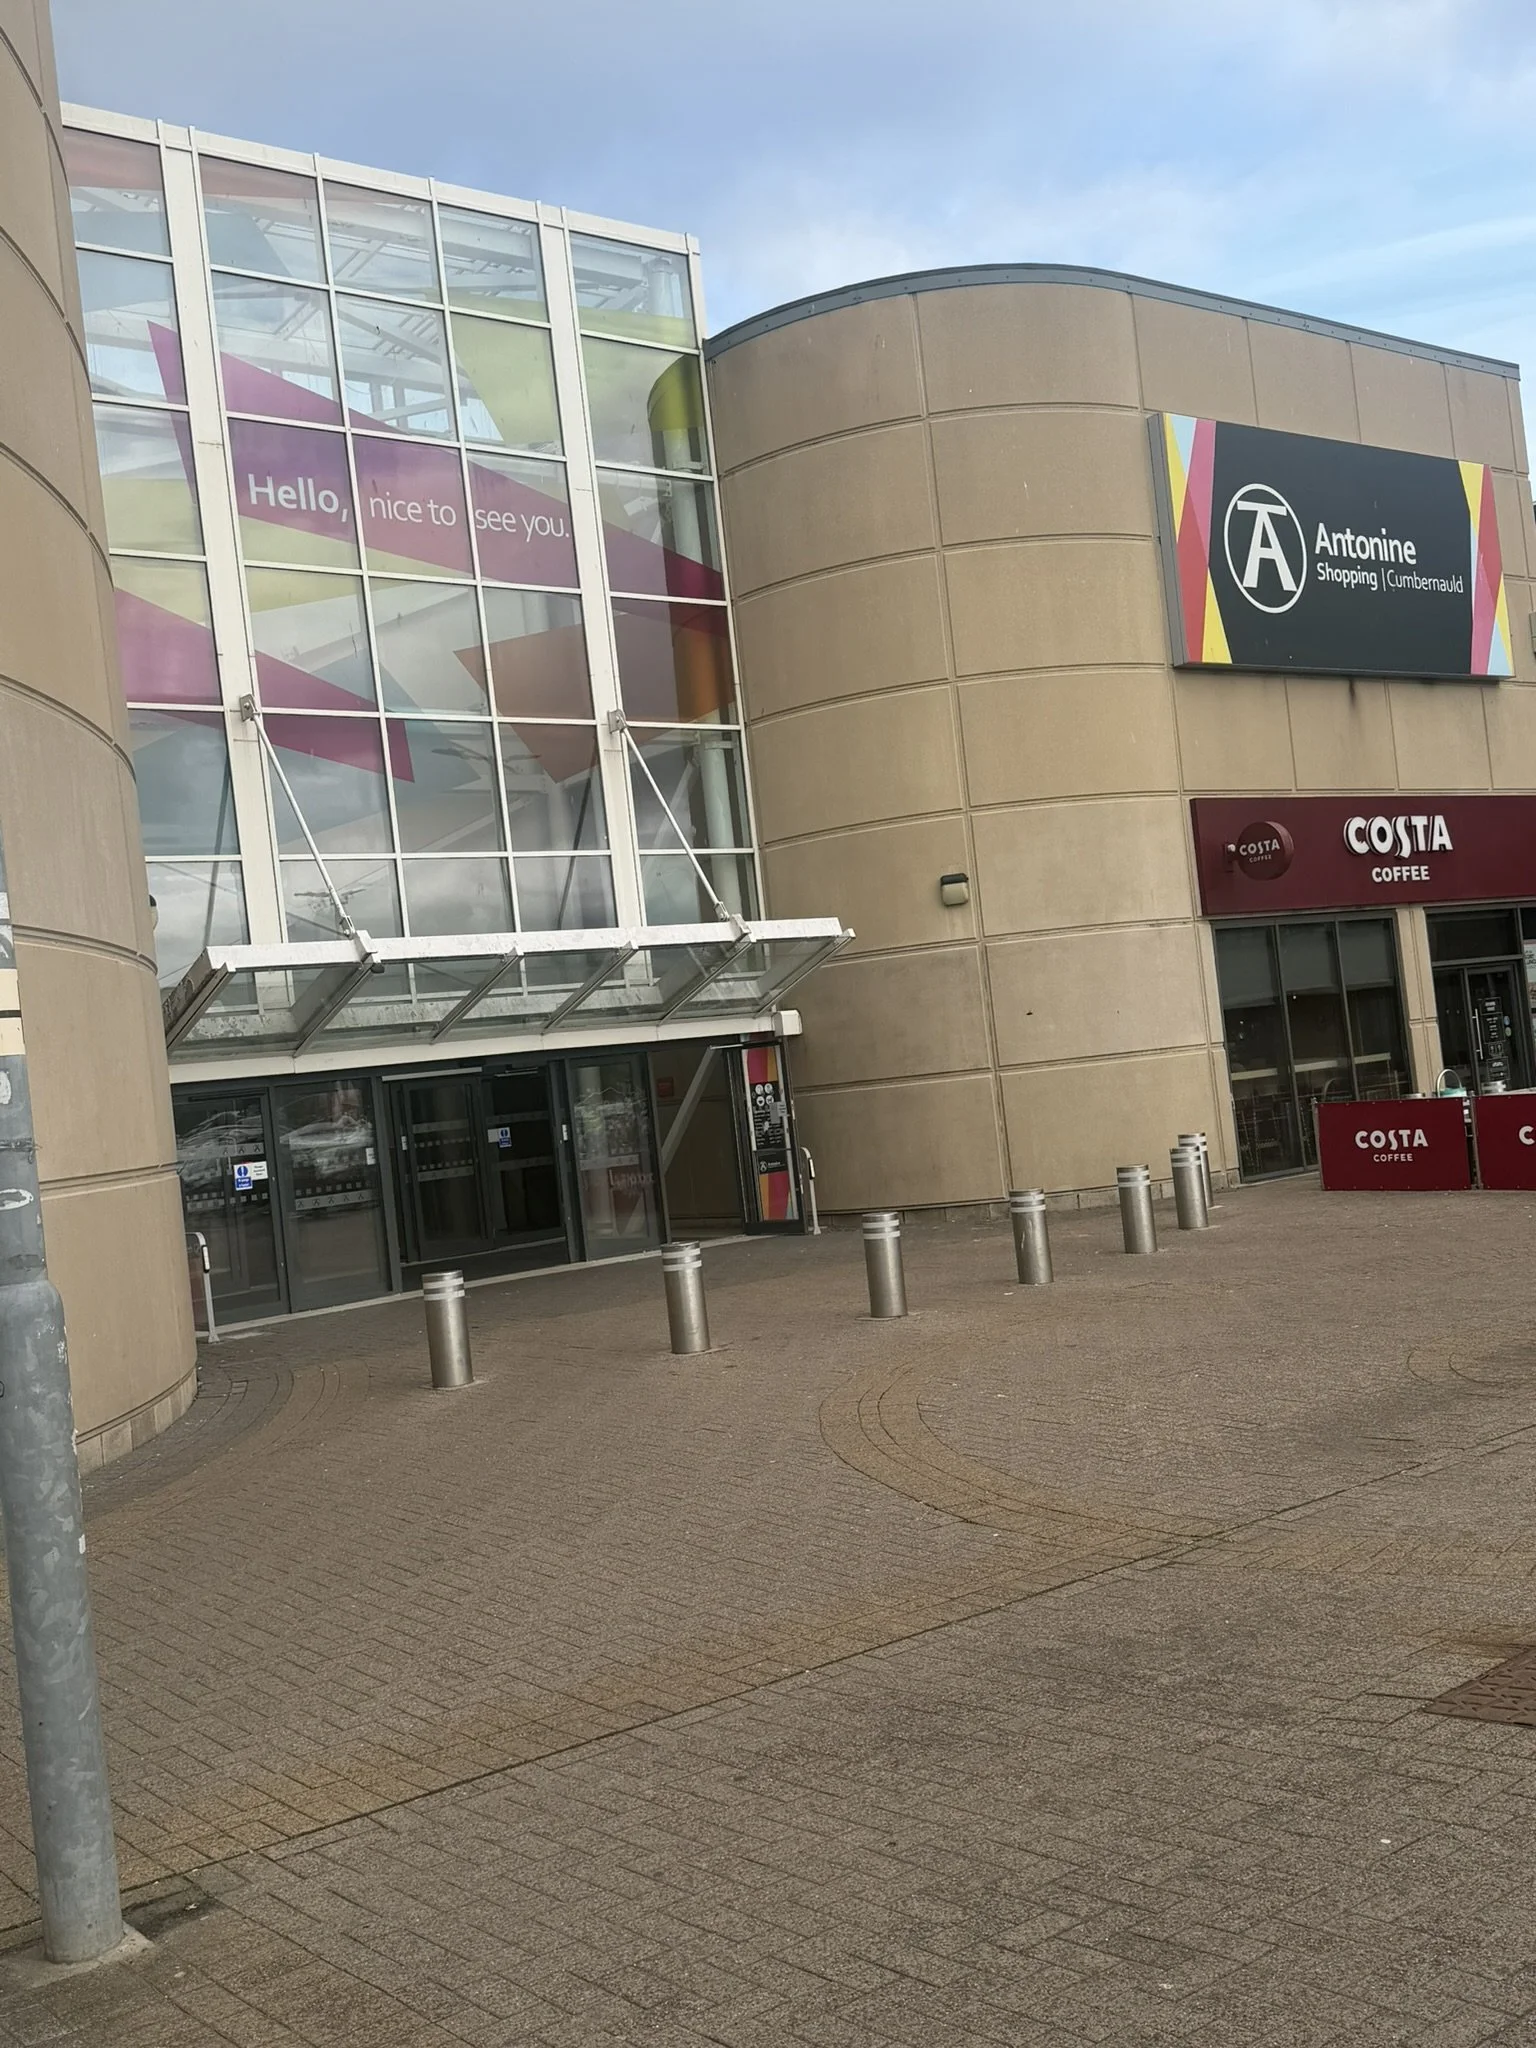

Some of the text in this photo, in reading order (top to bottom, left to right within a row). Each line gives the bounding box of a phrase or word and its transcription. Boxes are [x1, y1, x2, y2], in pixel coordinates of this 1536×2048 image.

[248, 473, 570, 543] Hello, nice to see you.
[1315, 522, 1417, 565] Antonine
[1316, 562, 1379, 591] Shopping
[1386, 569, 1464, 593] Cumbernauld
[1239, 838, 1281, 856] COSTA
[1343, 815, 1453, 858] COSTA
[1371, 865, 1430, 883] COFFEE
[1354, 1128, 1429, 1151] COSTA
[1373, 1153, 1414, 1163] COFFEE
